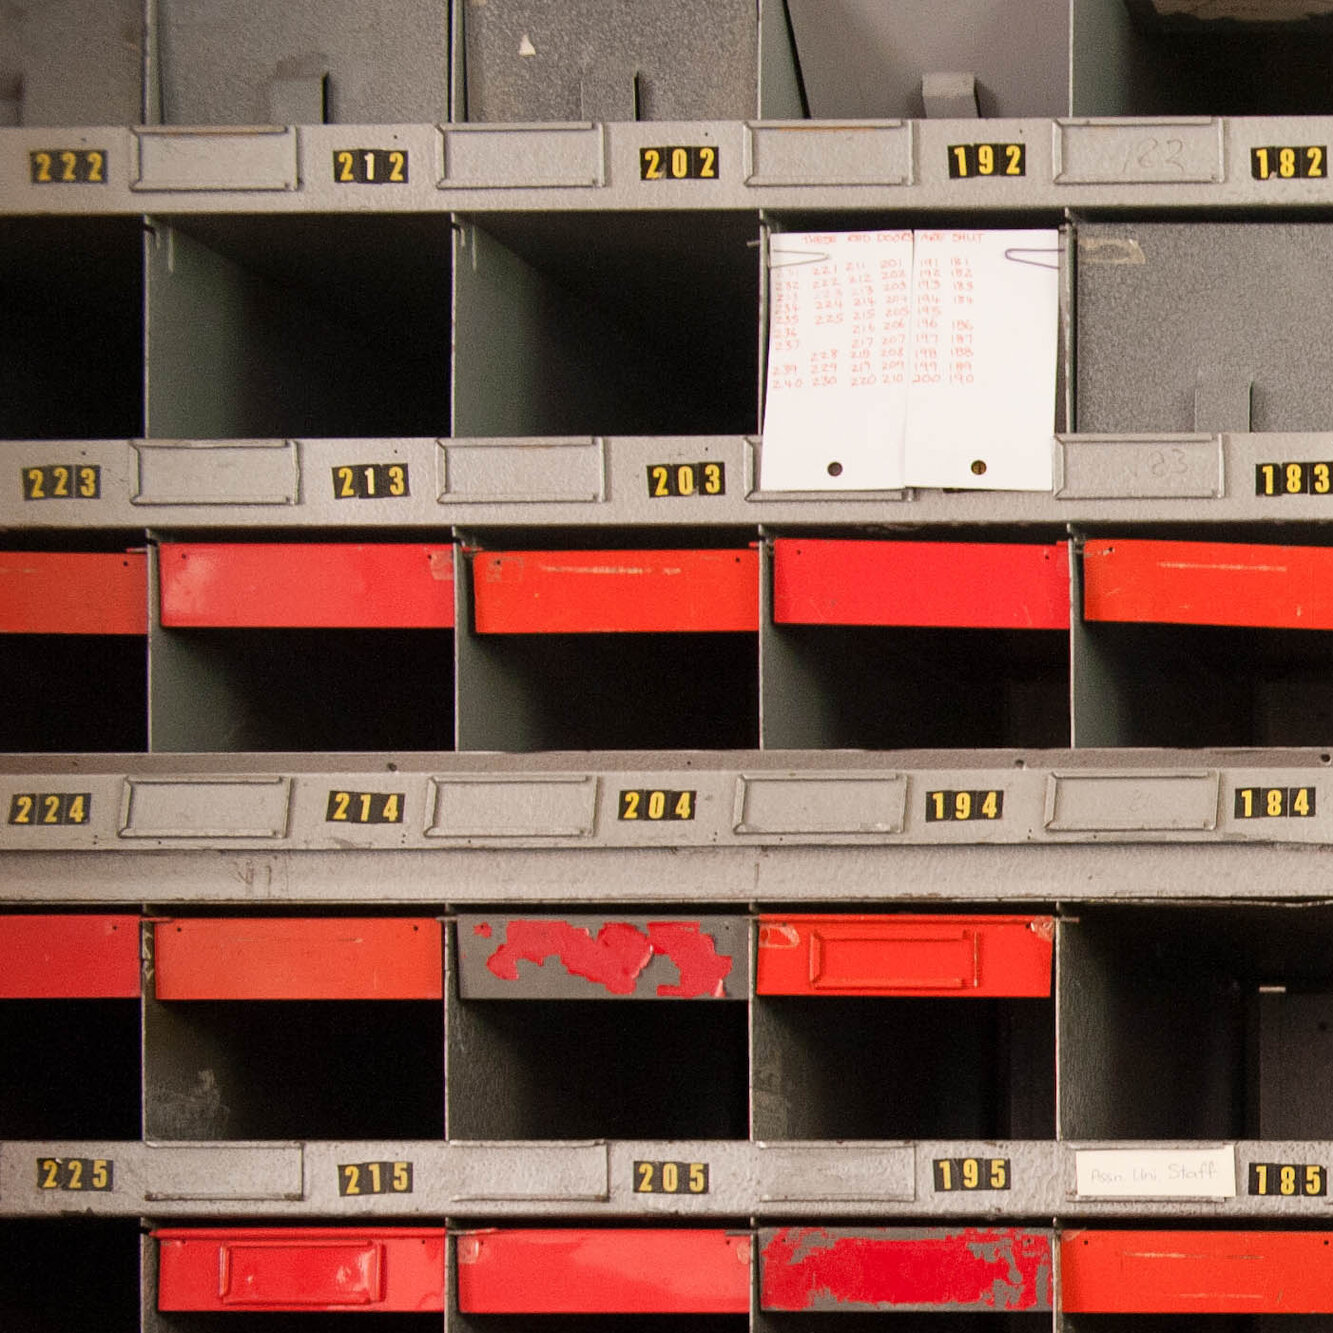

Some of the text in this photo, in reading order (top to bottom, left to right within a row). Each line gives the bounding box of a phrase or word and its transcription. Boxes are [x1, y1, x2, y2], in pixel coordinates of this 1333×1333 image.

[37, 152, 102, 181] 222
[338, 151, 404, 181] 212
[645, 146, 714, 179] 202
[954, 144, 1021, 176] 192
[1256, 146, 1322, 179] 182
[29, 467, 95, 497] 223
[338, 465, 404, 496] 213
[653, 464, 720, 497] 203
[1262, 464, 1329, 495] 183
[16, 796, 84, 823] 224
[333, 792, 398, 822] 214
[624, 790, 690, 820] 204
[932, 790, 997, 820] 194
[1241, 788, 1309, 817] 184
[43, 1159, 107, 1188] 225
[344, 1162, 408, 1194] 215
[638, 1162, 705, 1192] 205
[939, 1158, 1005, 1190] 195
[1168, 1161, 1216, 1180] Staff
[1256, 1165, 1320, 1195] 185
